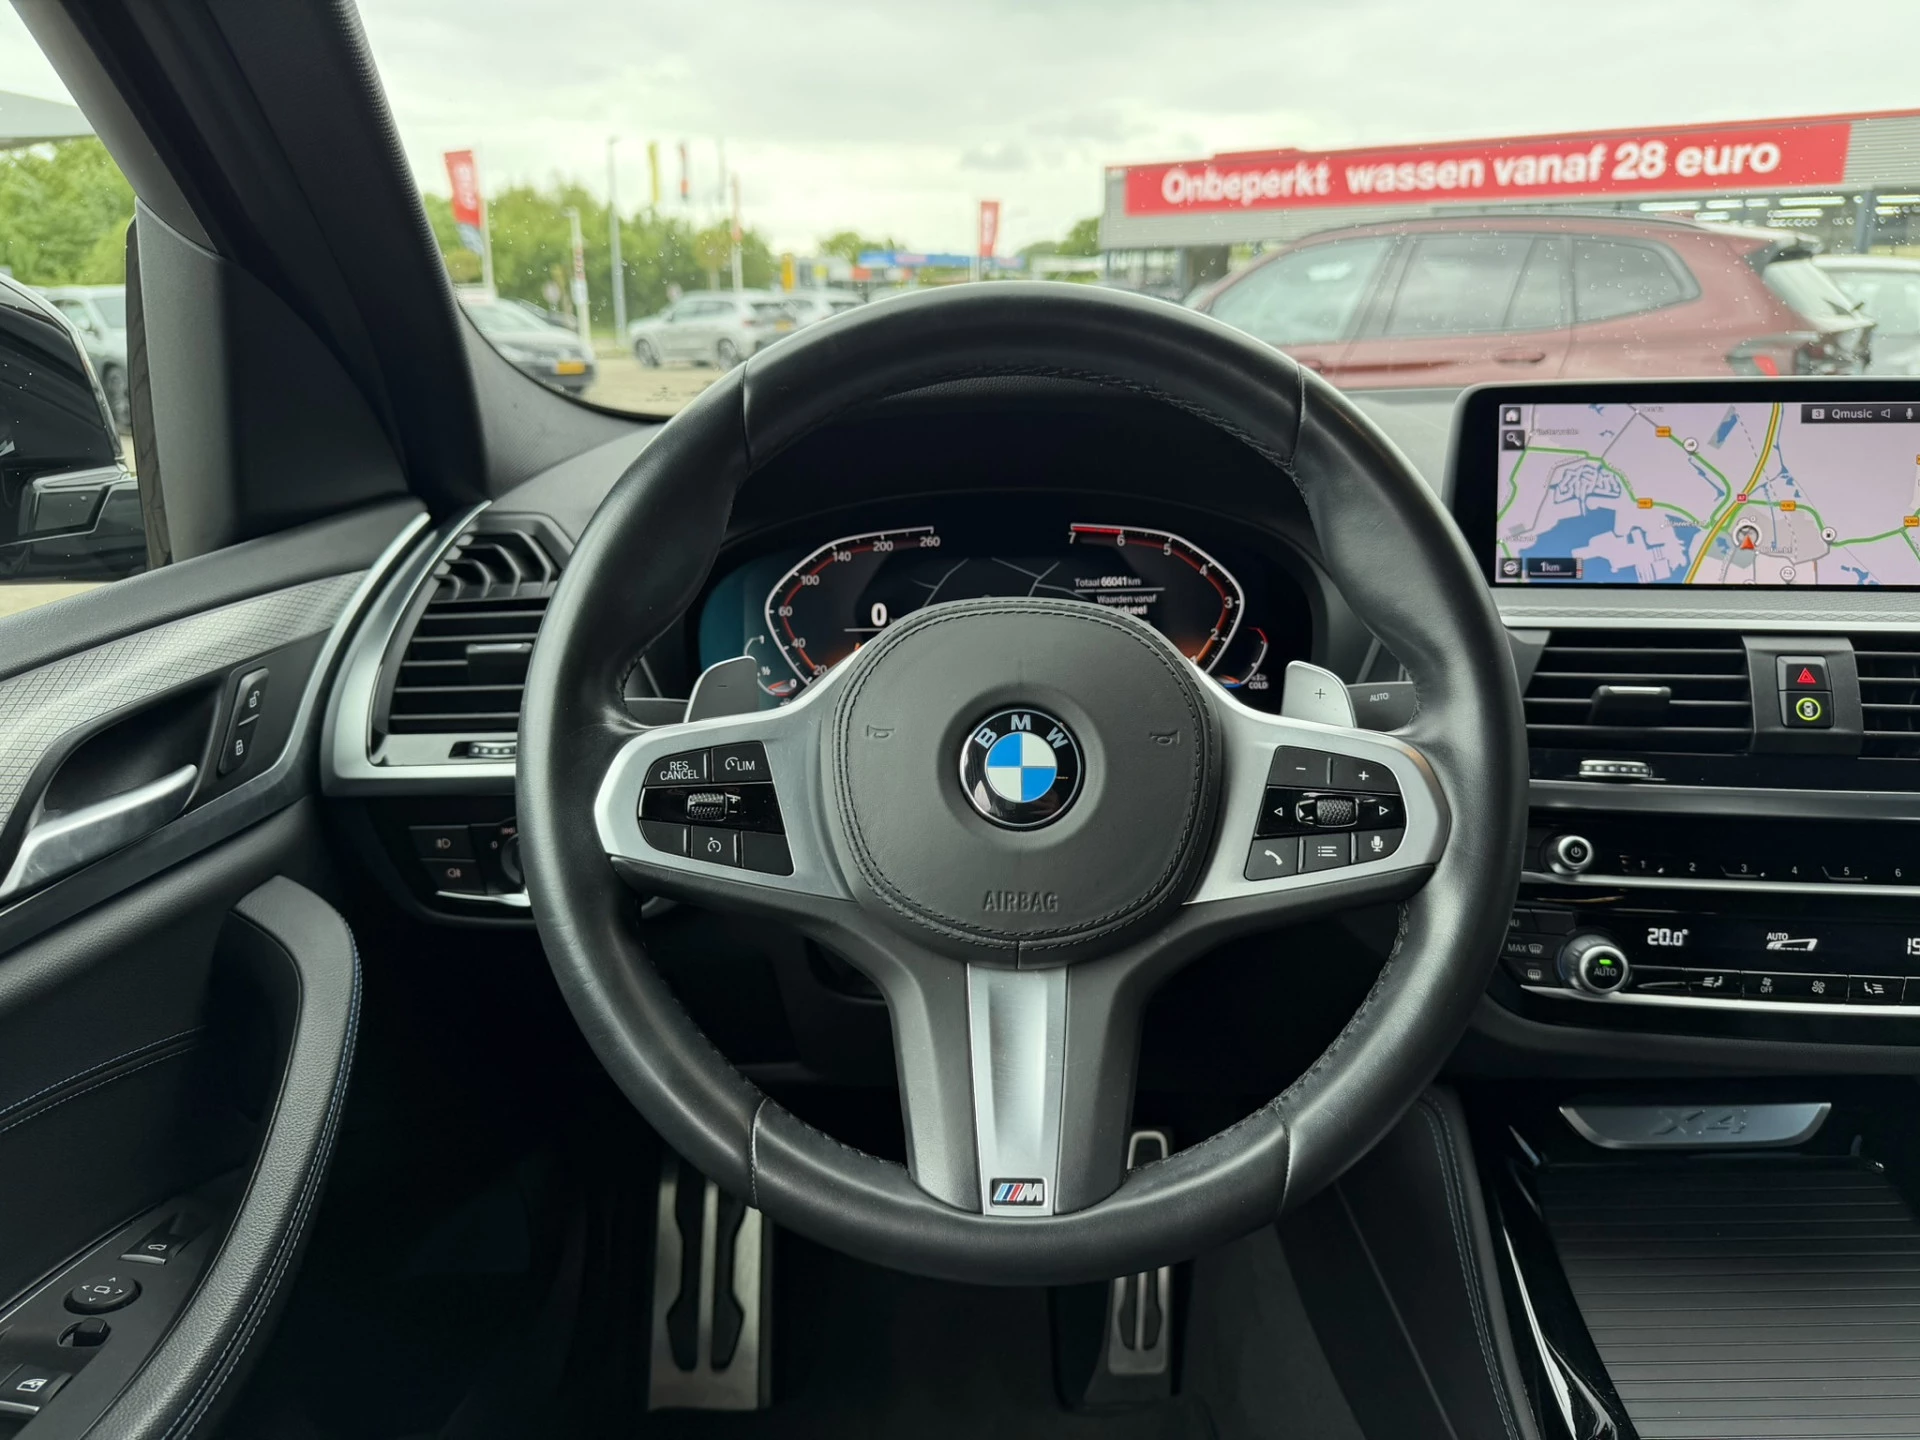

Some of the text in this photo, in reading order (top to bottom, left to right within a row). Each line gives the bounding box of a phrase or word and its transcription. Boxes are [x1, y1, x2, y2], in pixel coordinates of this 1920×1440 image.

[1161, 140, 1781, 206] Onbeperkt wassen vanaf 28 euro
[1831, 408, 1873, 419] Qmusic
[919, 536, 941, 547] 260
[1068, 532, 1076, 544] 7
[1116, 535, 1125, 546] 6
[873, 541, 893, 552] 200
[1163, 544, 1172, 556] 5
[832, 552, 851, 562] 140
[1199, 565, 1208, 576] 4
[801, 575, 820, 586] 100
[1074, 576, 1142, 587] Totaal 66041 km
[1096, 594, 1157, 604] Waarden vanaf
[1224, 597, 1233, 608] 3
[778, 606, 793, 617] 60
[871, 602, 888, 627] 0
[1210, 628, 1219, 640] 2
[791, 637, 806, 648] 40
[813, 664, 828, 675] 20
[1248, 681, 1269, 690] COLD
[1369, 692, 1390, 702] AUTO
[975, 714, 1068, 750] BMW
[669, 760, 689, 771] RES
[737, 760, 756, 771] LIM
[660, 769, 700, 781] CANCEL
[1689, 862, 1696, 872] 2
[1740, 863, 1747, 873] 3
[1791, 865, 1798, 875] 4
[1843, 867, 1850, 876] 5
[1894, 868, 1902, 878] 6
[983, 890, 1059, 914] AIRBAG
[1766, 932, 1789, 941] AUTO
[1507, 943, 1527, 953] MAX
[1593, 966, 1617, 978] AUTO
[1760, 985, 1774, 994] OFF
[1653, 1108, 1748, 1136] X4
